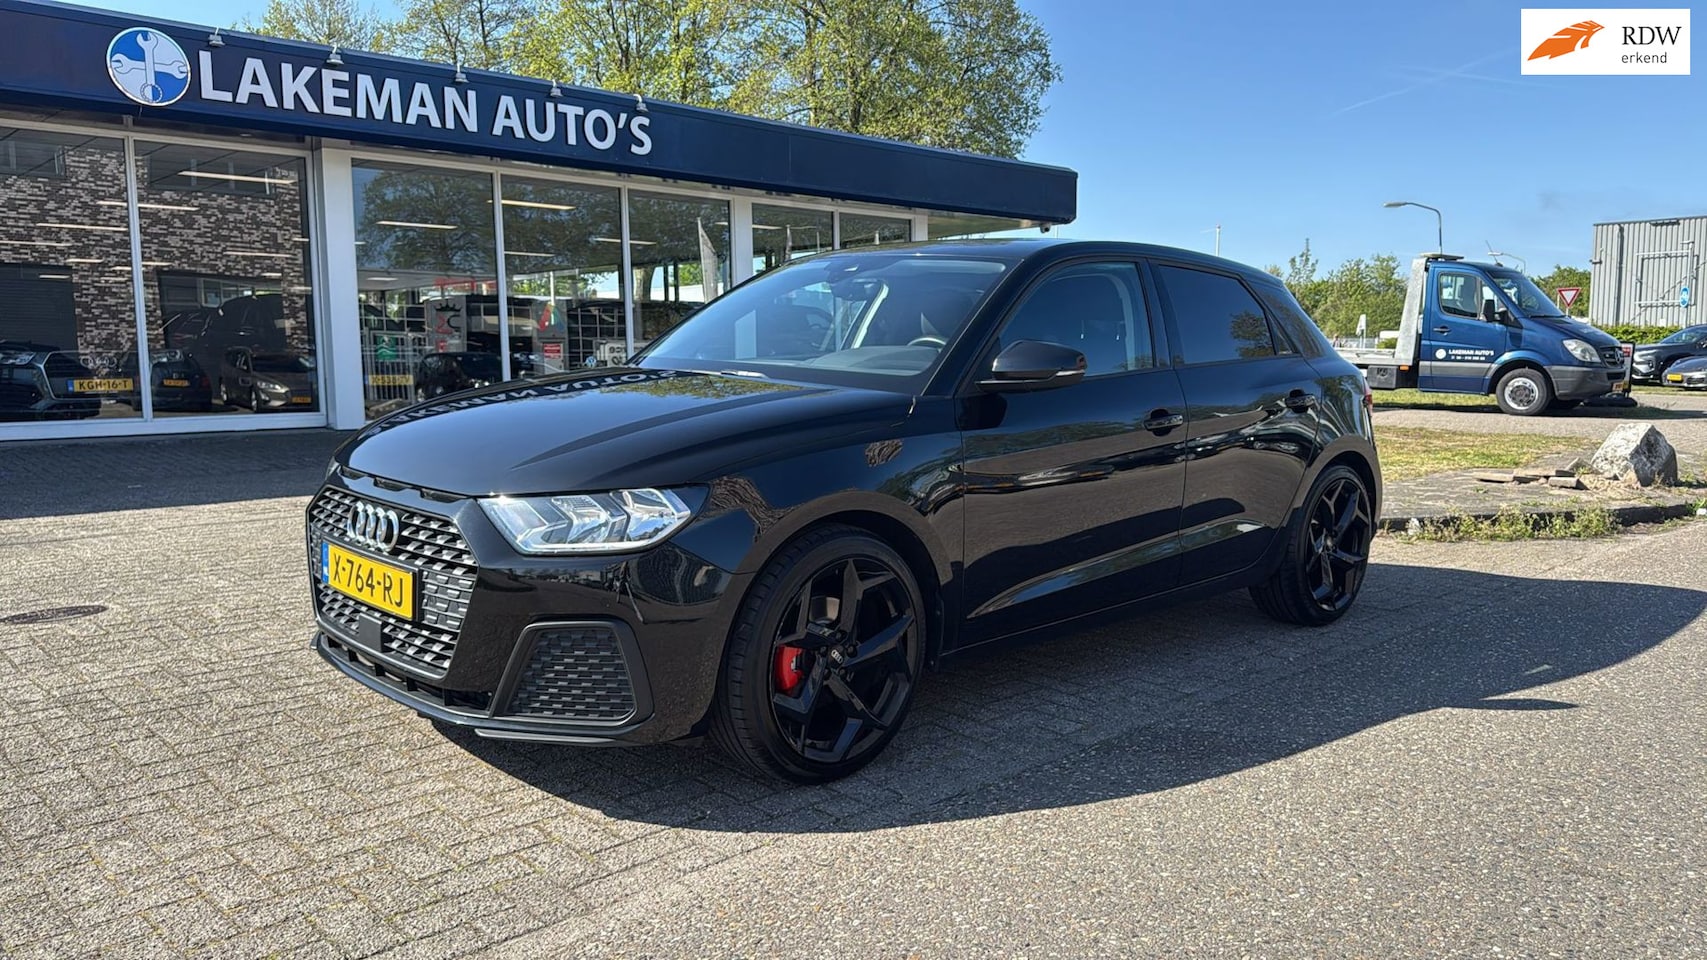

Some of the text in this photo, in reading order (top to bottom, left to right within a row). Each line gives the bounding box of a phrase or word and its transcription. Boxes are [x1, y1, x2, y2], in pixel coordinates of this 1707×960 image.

[199, 50, 653, 155] LAKEMAN AUTO'S
[78, 380, 129, 391] KGH-16-T
[333, 552, 404, 608] X-764-RJ
